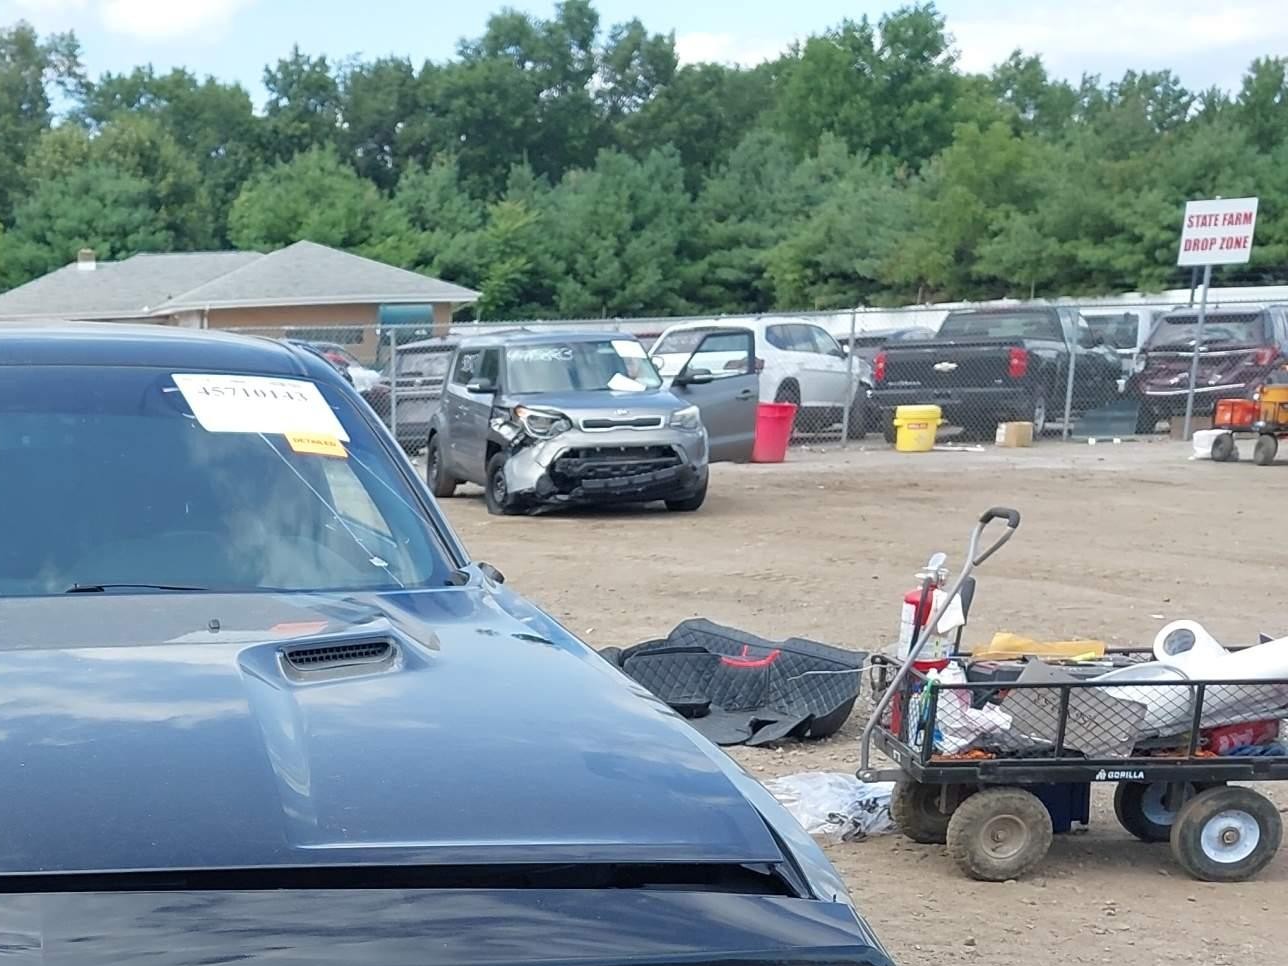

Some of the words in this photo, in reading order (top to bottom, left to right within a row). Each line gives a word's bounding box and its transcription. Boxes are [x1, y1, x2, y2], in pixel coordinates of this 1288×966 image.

[1187, 214, 1220, 228] STATE
[1222, 211, 1253, 226] FARM
[1184, 238, 1216, 252] DROP
[1219, 236, 1249, 250] ZONE
[1107, 771, 1144, 779] GORILLA
